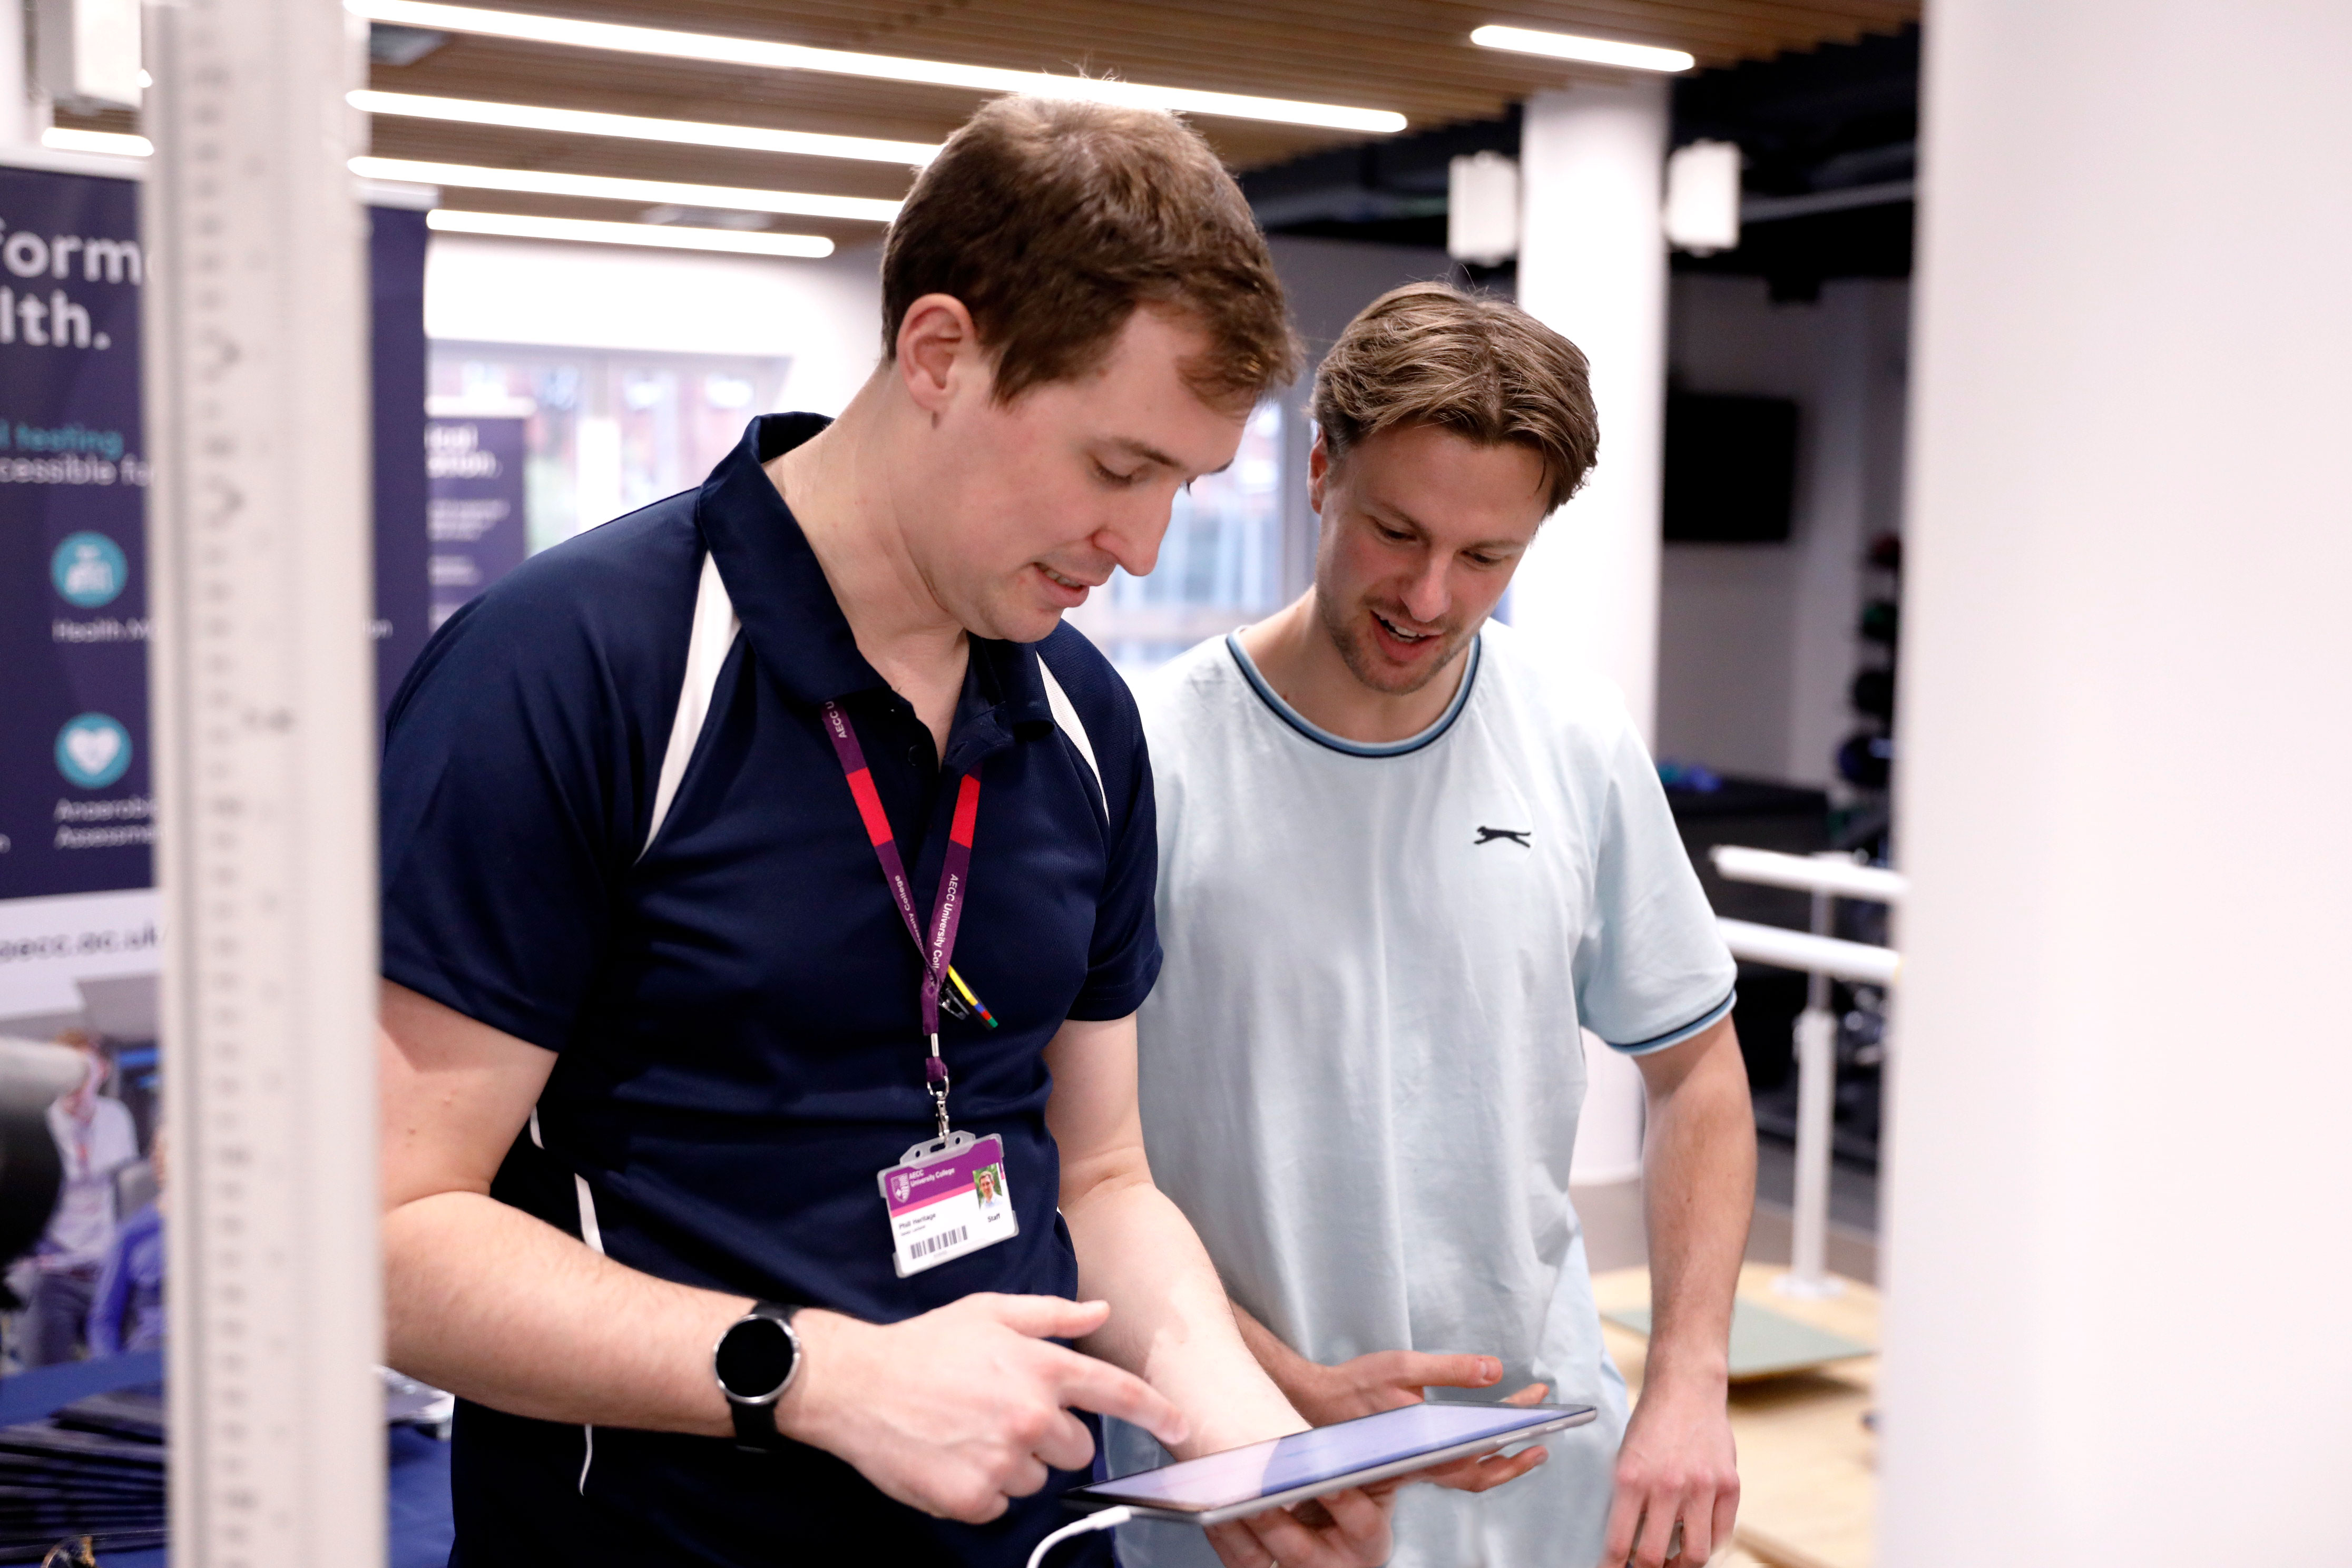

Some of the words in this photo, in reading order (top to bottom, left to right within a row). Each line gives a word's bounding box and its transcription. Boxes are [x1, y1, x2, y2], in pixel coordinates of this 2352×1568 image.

[829, 710, 847, 738] AECC
[895, 875, 910, 911] College
[946, 873, 959, 901] AECC
[934, 903, 954, 948] University
[909, 1169, 925, 1180] AECC
[910, 1174, 936, 1187] University
[935, 1168, 955, 1179] College
[987, 1212, 1001, 1222] Staff
